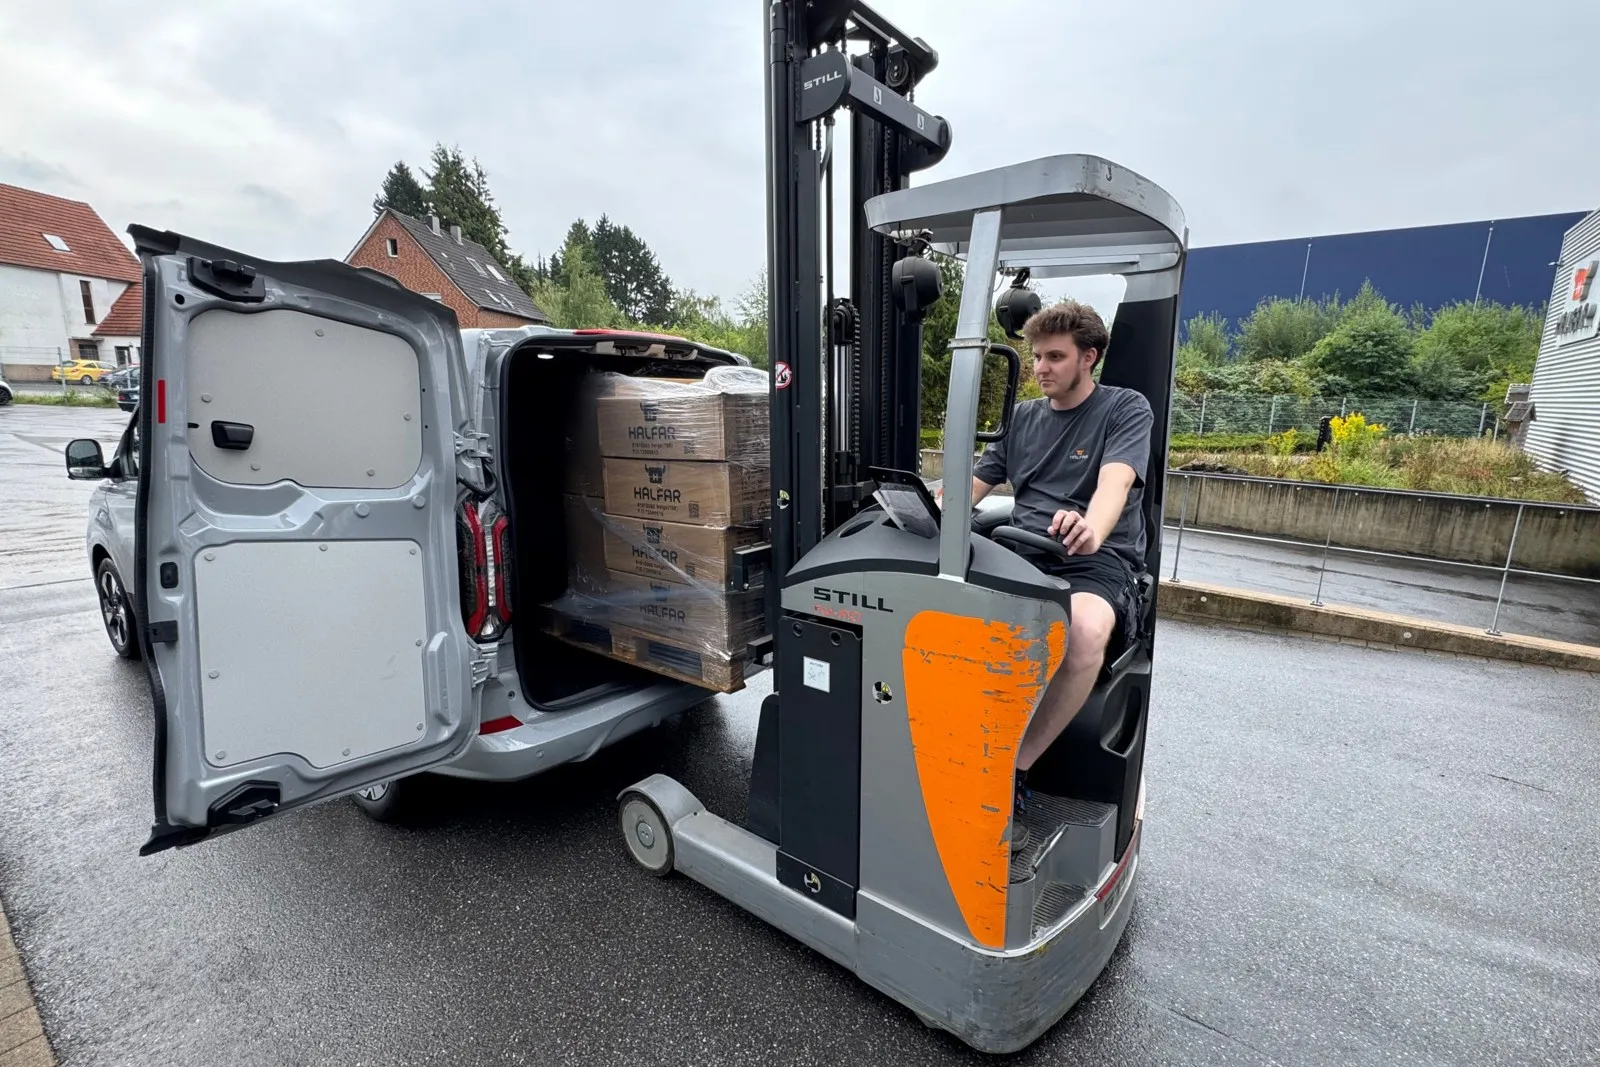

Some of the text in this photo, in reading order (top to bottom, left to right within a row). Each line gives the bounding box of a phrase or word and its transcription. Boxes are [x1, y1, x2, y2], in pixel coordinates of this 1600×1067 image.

[803, 70, 842, 90] STILL
[628, 426, 676, 440] HALFAR
[633, 486, 681, 503] HALFAR
[813, 586, 894, 613] STILL
[640, 603, 686, 623] HALFAR
